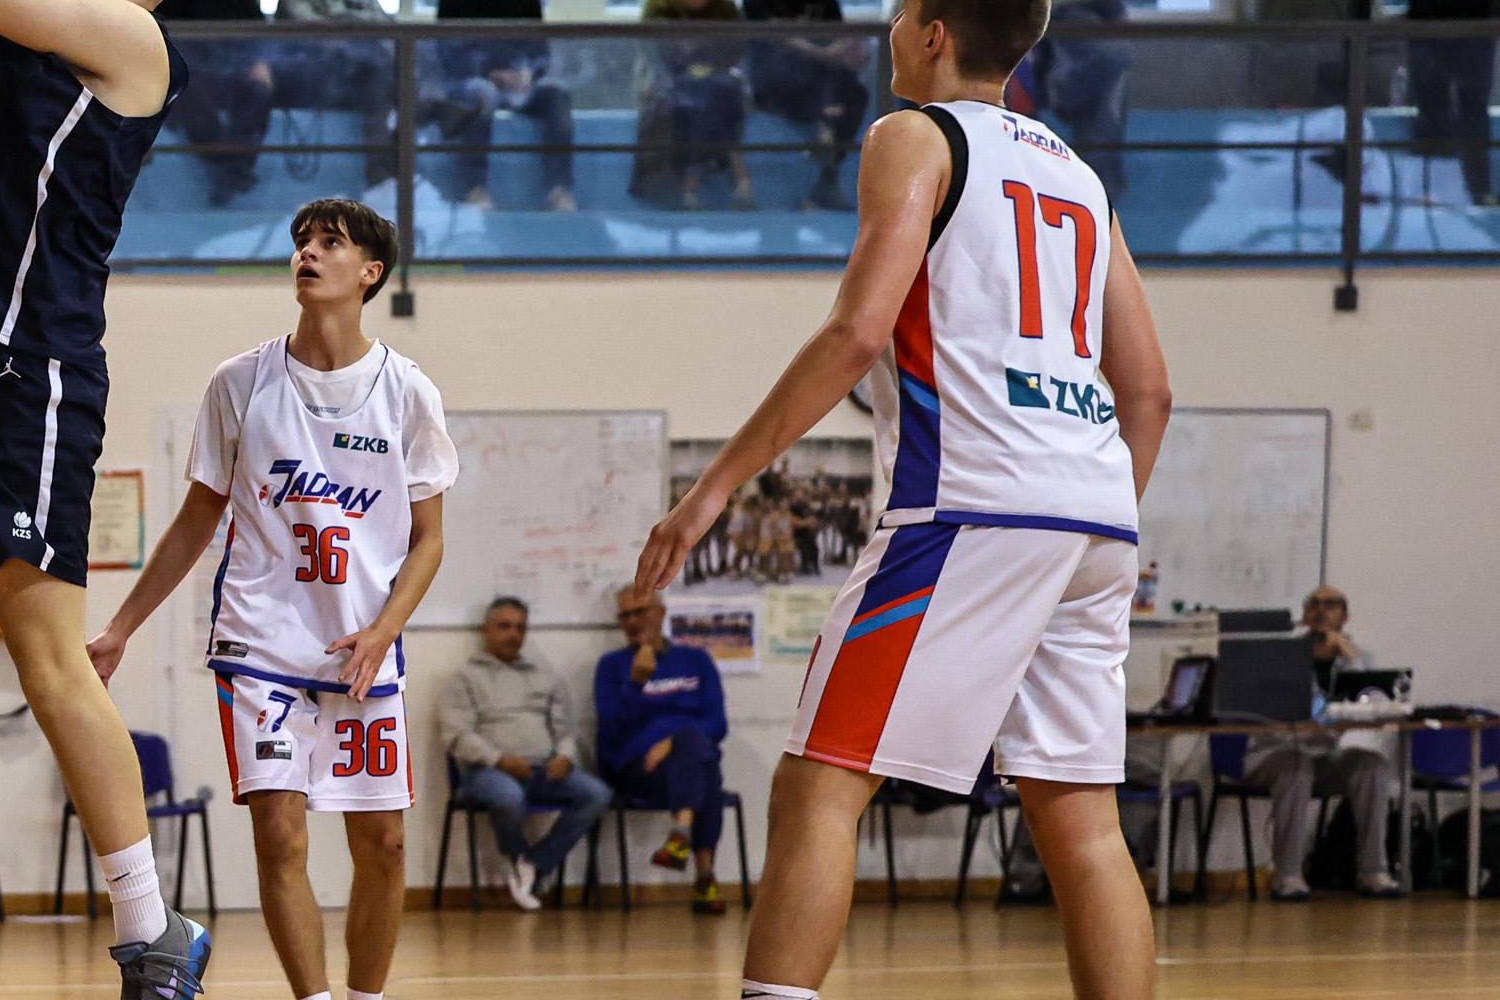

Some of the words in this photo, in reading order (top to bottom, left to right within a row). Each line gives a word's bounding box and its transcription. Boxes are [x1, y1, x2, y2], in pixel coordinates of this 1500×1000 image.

[1002, 180, 1097, 359] 17
[350, 435, 389, 454] ZKB
[268, 459, 382, 512] JADRAN
[12, 528, 32, 540] KZS
[292, 523, 351, 585] 36
[332, 716, 398, 778] 36
